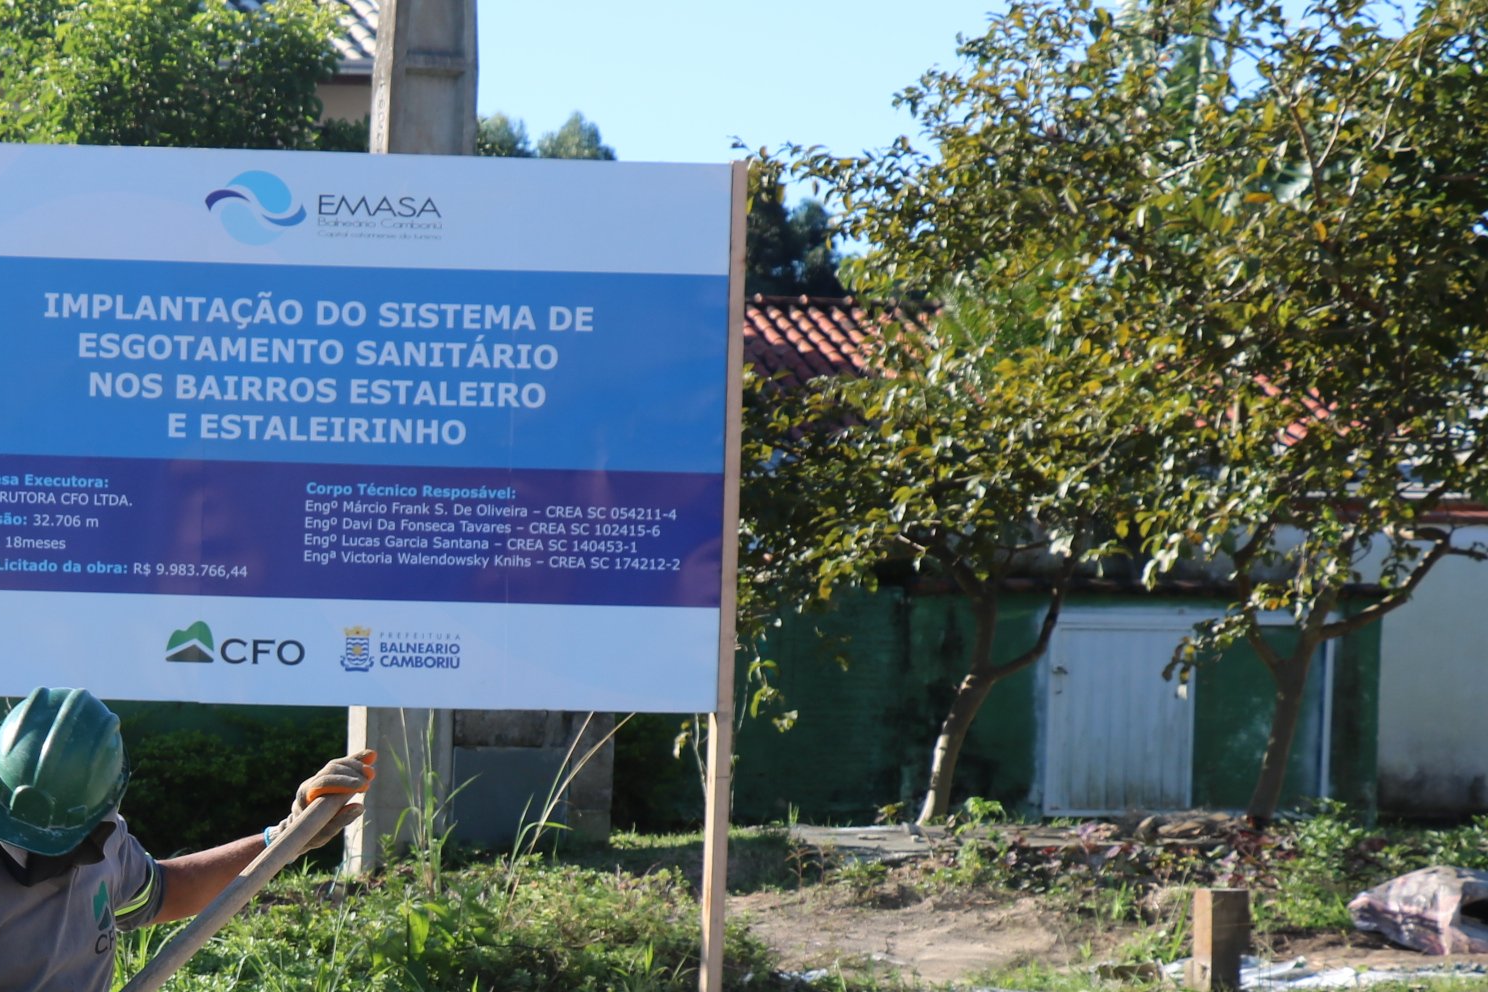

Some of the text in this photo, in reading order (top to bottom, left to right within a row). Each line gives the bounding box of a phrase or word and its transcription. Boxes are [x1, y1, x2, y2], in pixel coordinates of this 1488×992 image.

[318, 194, 442, 218] EMASA
[318, 216, 442, 230] Balneário Camboriú
[44, 292, 594, 332] IMPLANTAÇÃO DO SISTEMA DE
[78, 333, 559, 370] ESGOTAMENTO SANITÁRIO
[89, 372, 546, 409] NOS BAIRROS ESTALEIRO
[168, 413, 467, 445] E ESTALEIRINHO
[24, 474, 109, 488] Executora:
[61, 492, 89, 506] CFO
[93, 493, 133, 507] LTDA.
[306, 482, 516, 501] Corpo Técnico Resposável:
[306, 499, 338, 515] Engº
[343, 500, 388, 514] Márcio
[392, 501, 430, 515] Frank
[434, 503, 448, 515] S.
[454, 504, 472, 516] De
[476, 504, 528, 518] Oliveira
[546, 506, 583, 519] CREA
[587, 507, 606, 519] SC
[611, 507, 677, 520] 054211-4
[33, 514, 81, 528] 32.706
[85, 518, 99, 528] m
[305, 516, 338, 532] Engº
[342, 517, 373, 530] Davi
[377, 519, 396, 531] Da
[400, 519, 455, 533] Fonseca
[460, 521, 512, 534] Tavares
[529, 522, 566, 535] CREA
[570, 523, 590, 536] SC
[595, 524, 661, 537] 102415-6
[5, 536, 66, 550] 18meses
[304, 533, 338, 549] Engº
[342, 534, 381, 547] Lucas
[385, 535, 428, 549] Garcia
[432, 536, 489, 550] Santana
[507, 538, 544, 551] CREA
[548, 539, 568, 552] SC
[573, 540, 637, 553] 140453-1
[62, 560, 82, 574] da
[86, 560, 128, 575] obra:
[133, 562, 152, 577] R$
[155, 563, 248, 579] 9.983.766,44
[341, 551, 393, 564] Victoria
[397, 552, 490, 569] Walendowsky
[494, 554, 532, 568] Knihs
[549, 556, 586, 569] CREA
[590, 557, 610, 570] SC
[615, 557, 681, 571] 174212-2
[380, 632, 461, 640] PREFEITURA
[220, 638, 305, 666] CFO
[379, 655, 461, 669] CAMBORIÚ
[95, 930, 115, 955] CF
